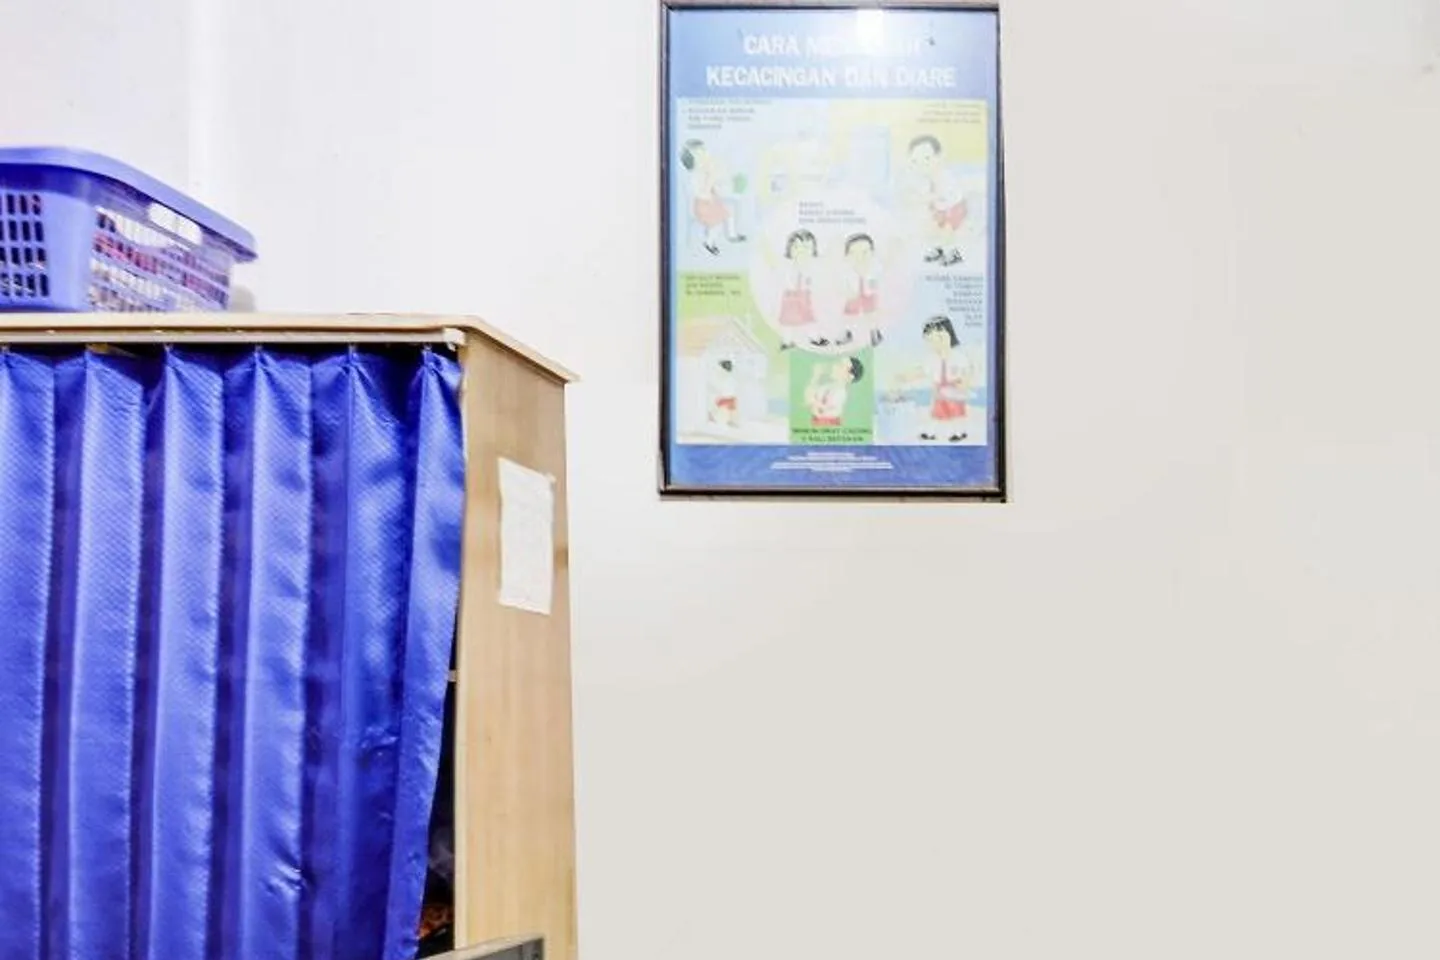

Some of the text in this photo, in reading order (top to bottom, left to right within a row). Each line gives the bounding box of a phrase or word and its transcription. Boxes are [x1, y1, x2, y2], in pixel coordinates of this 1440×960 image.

[743, 35, 800, 56] CARA
[706, 65, 835, 88] KECACINGAN
[845, 65, 891, 88] DAN
